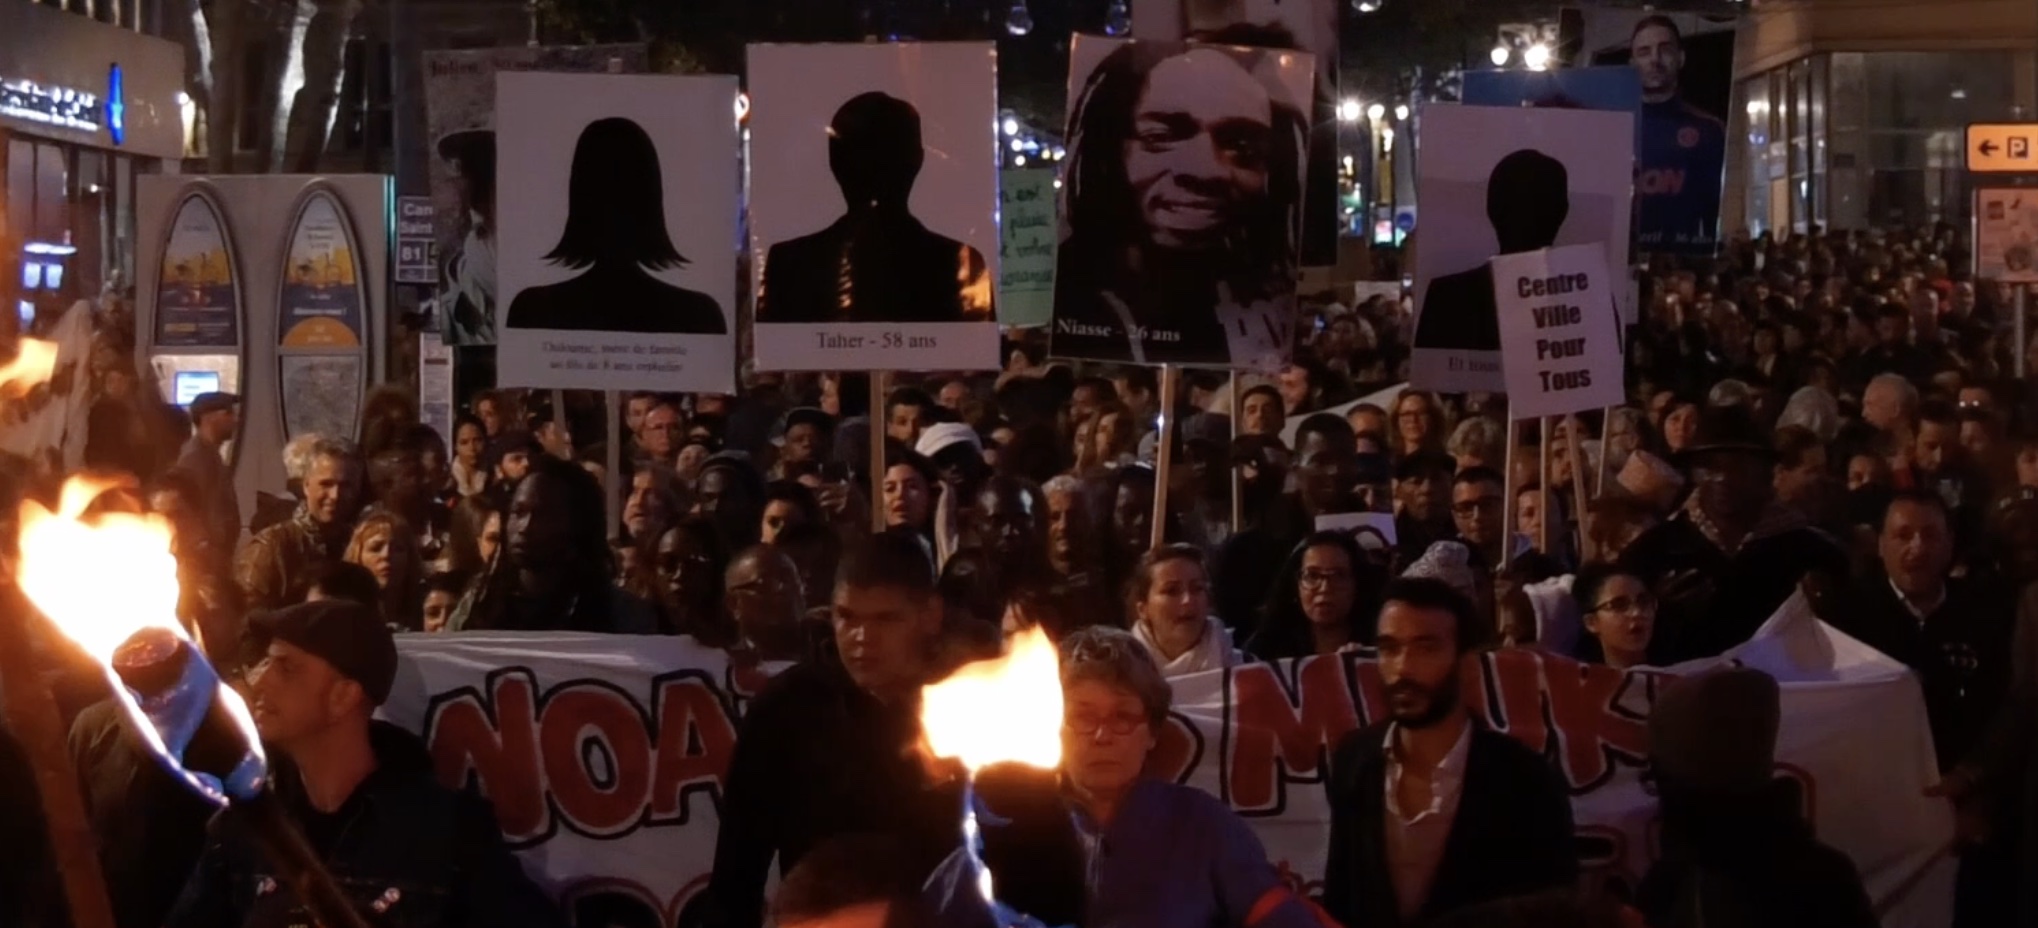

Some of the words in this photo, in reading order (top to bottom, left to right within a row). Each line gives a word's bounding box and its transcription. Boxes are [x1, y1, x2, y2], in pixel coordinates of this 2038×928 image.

[1639, 168, 1685, 194] ON
[403, 203, 434, 216] Can
[1517, 272, 1589, 299] Centre
[1531, 304, 1581, 329] Ville
[816, 331, 864, 349] Taher
[880, 331, 903, 349] 58
[908, 335, 938, 349] ans
[1058, 318, 1112, 337] Niasse
[1127, 324, 1148, 339] 26
[1152, 329, 1181, 341] ans
[1536, 336, 1586, 361] Pour
[1538, 368, 1592, 392] Tous
